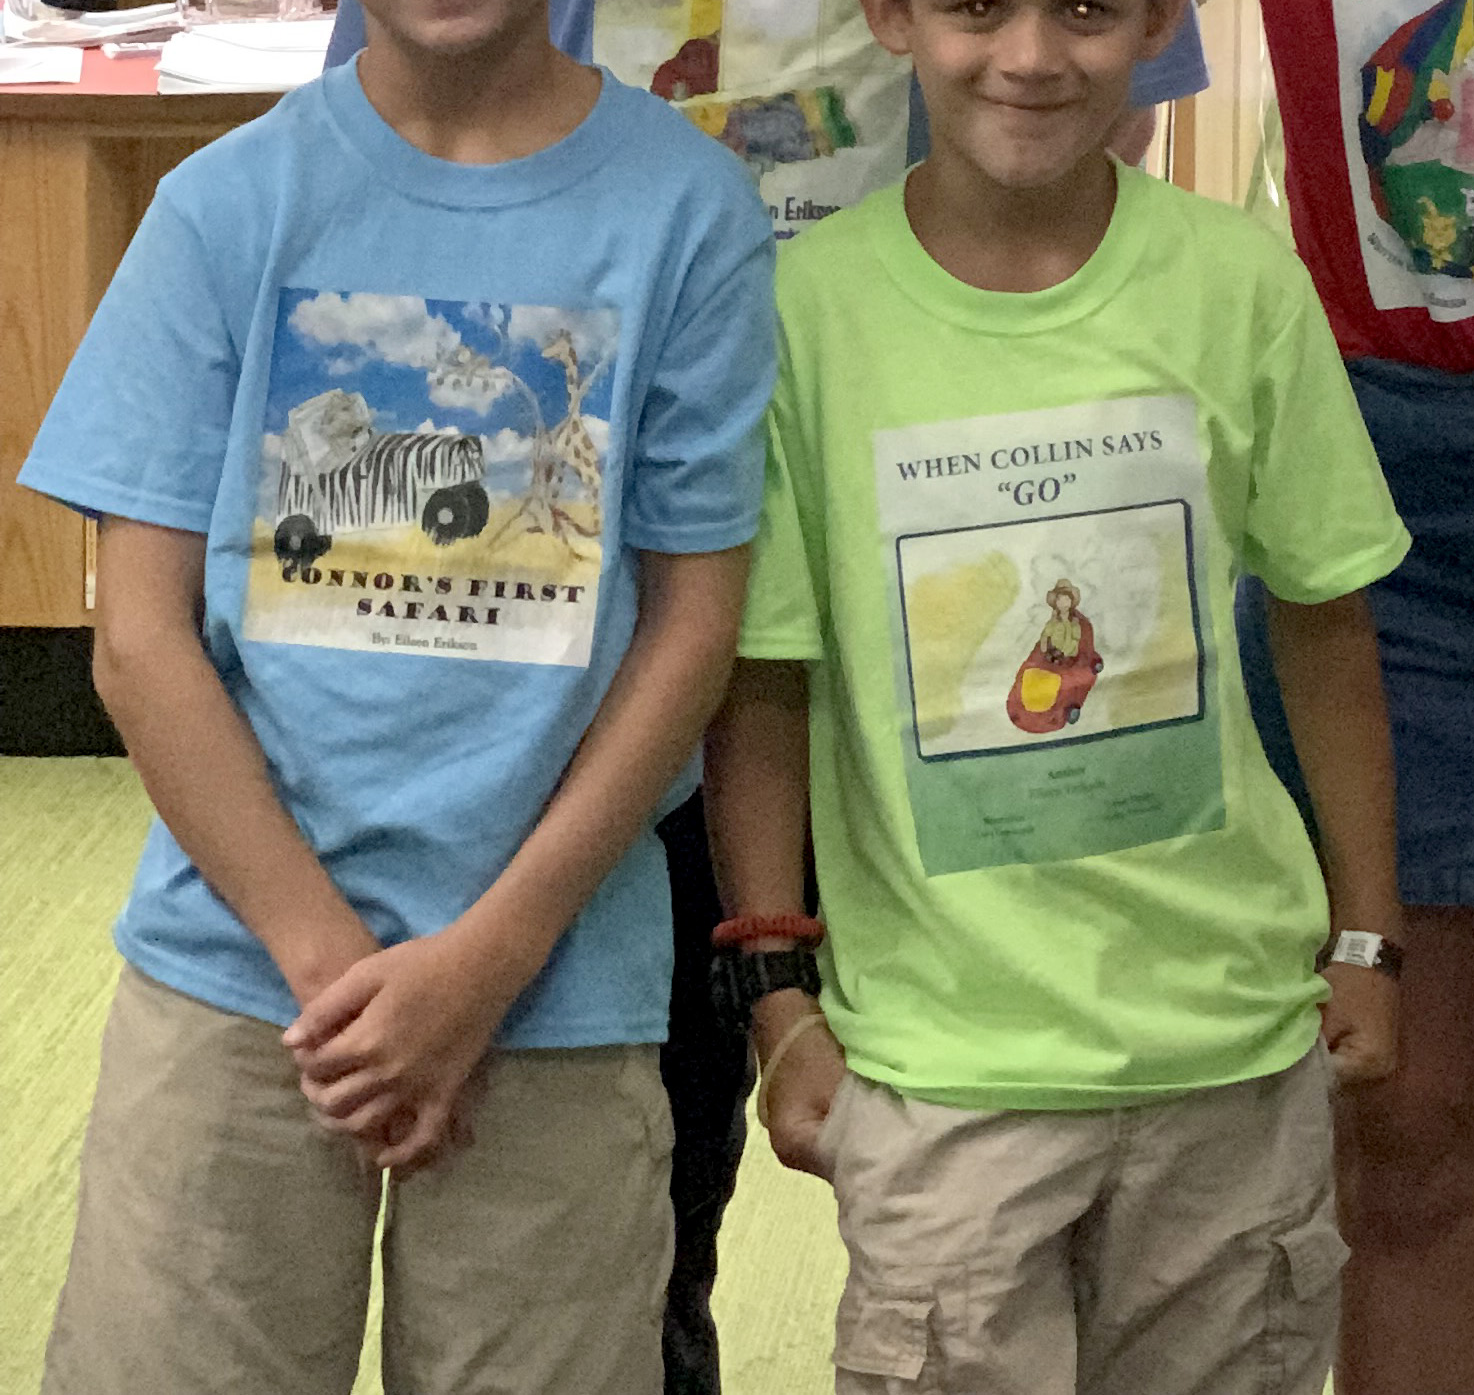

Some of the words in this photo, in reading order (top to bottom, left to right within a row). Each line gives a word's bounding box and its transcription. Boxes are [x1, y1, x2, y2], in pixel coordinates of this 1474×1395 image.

[896, 452, 981, 482] WHEN
[990, 438, 1094, 470] COLLIN
[1102, 429, 1164, 457] SAYS
[282, 567, 453, 594] CONNOR'S
[468, 579, 586, 603] FIRST
[357, 598, 501, 625] SAFARI
